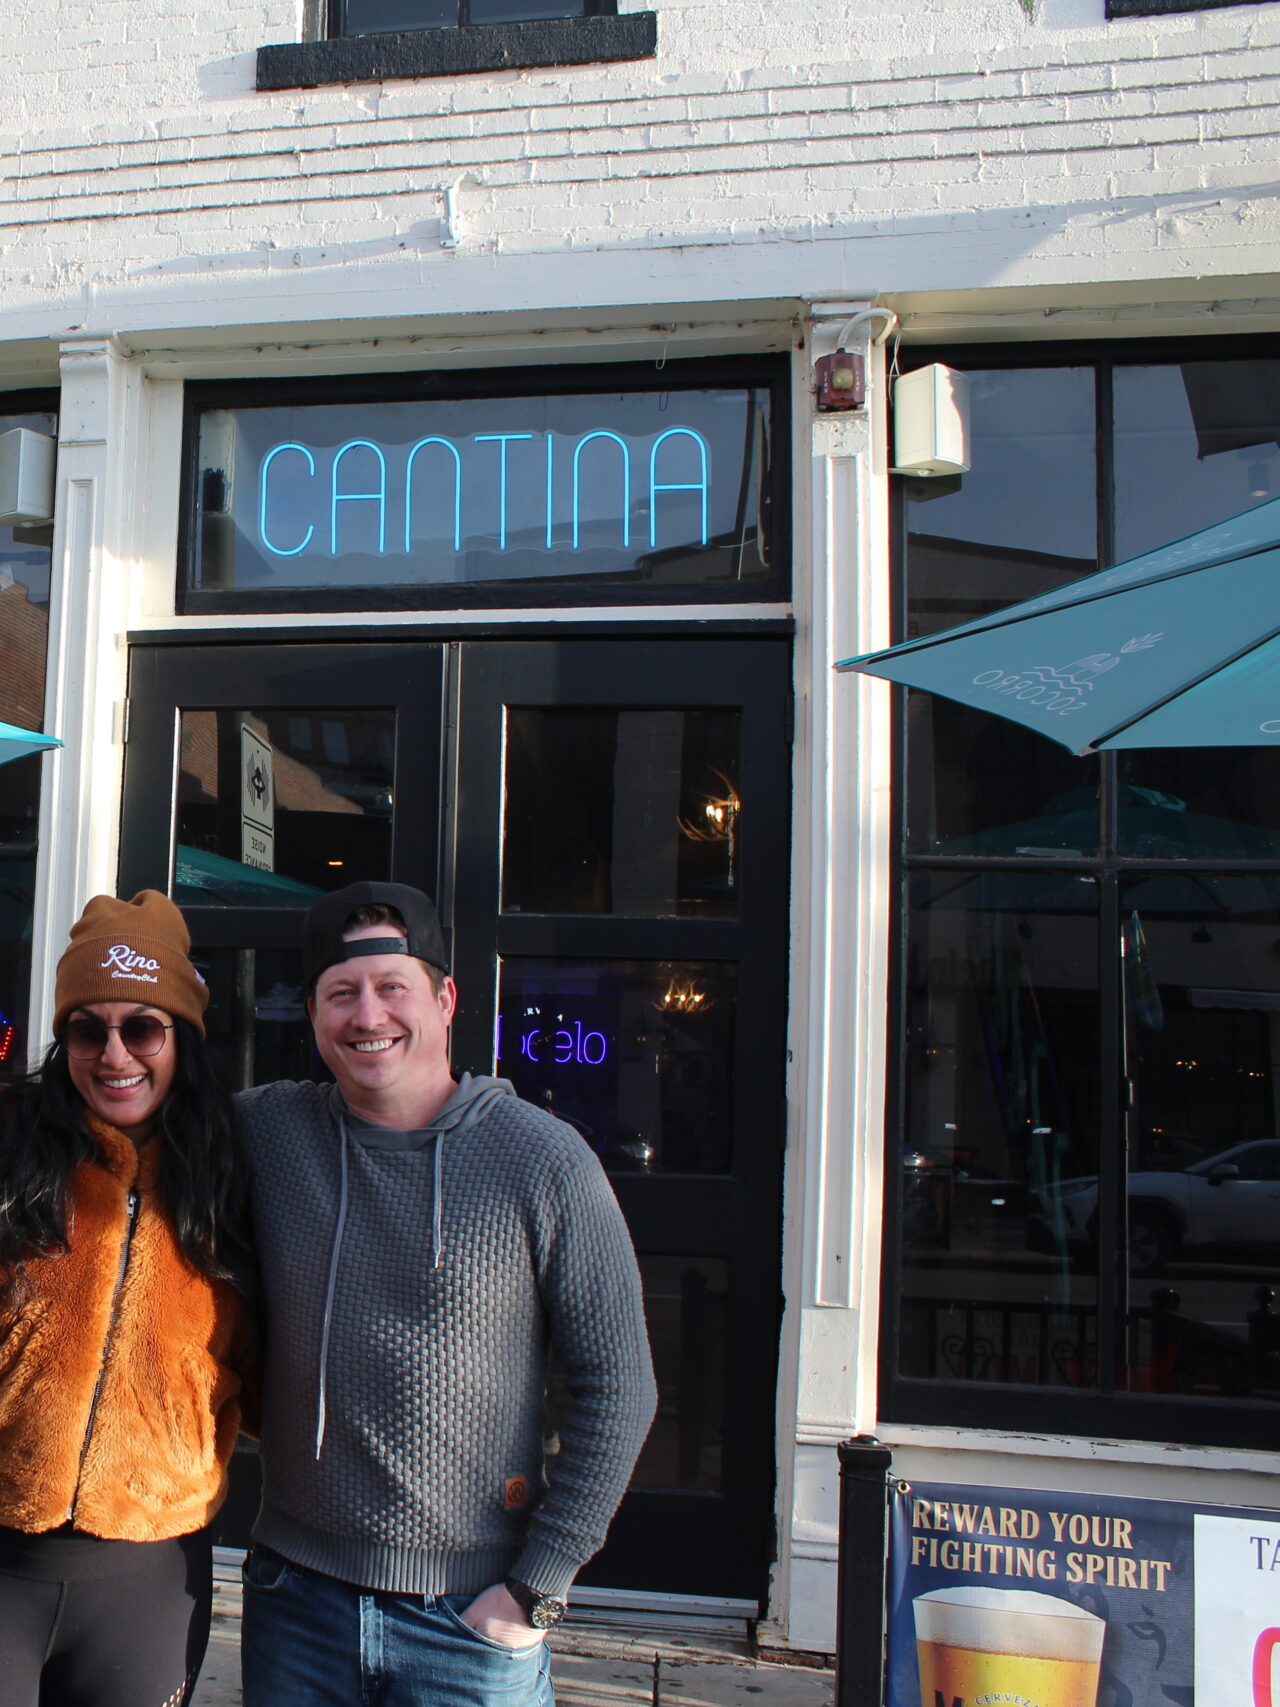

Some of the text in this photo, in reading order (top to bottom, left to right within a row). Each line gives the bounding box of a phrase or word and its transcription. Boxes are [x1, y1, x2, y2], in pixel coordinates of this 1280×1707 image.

[259, 427, 708, 556] CANTINA
[101, 944, 161, 972] Rino
[912, 1498, 1134, 1550] REWARD YOUR
[911, 1536, 1172, 1593] FIGHTING SPIRIT
